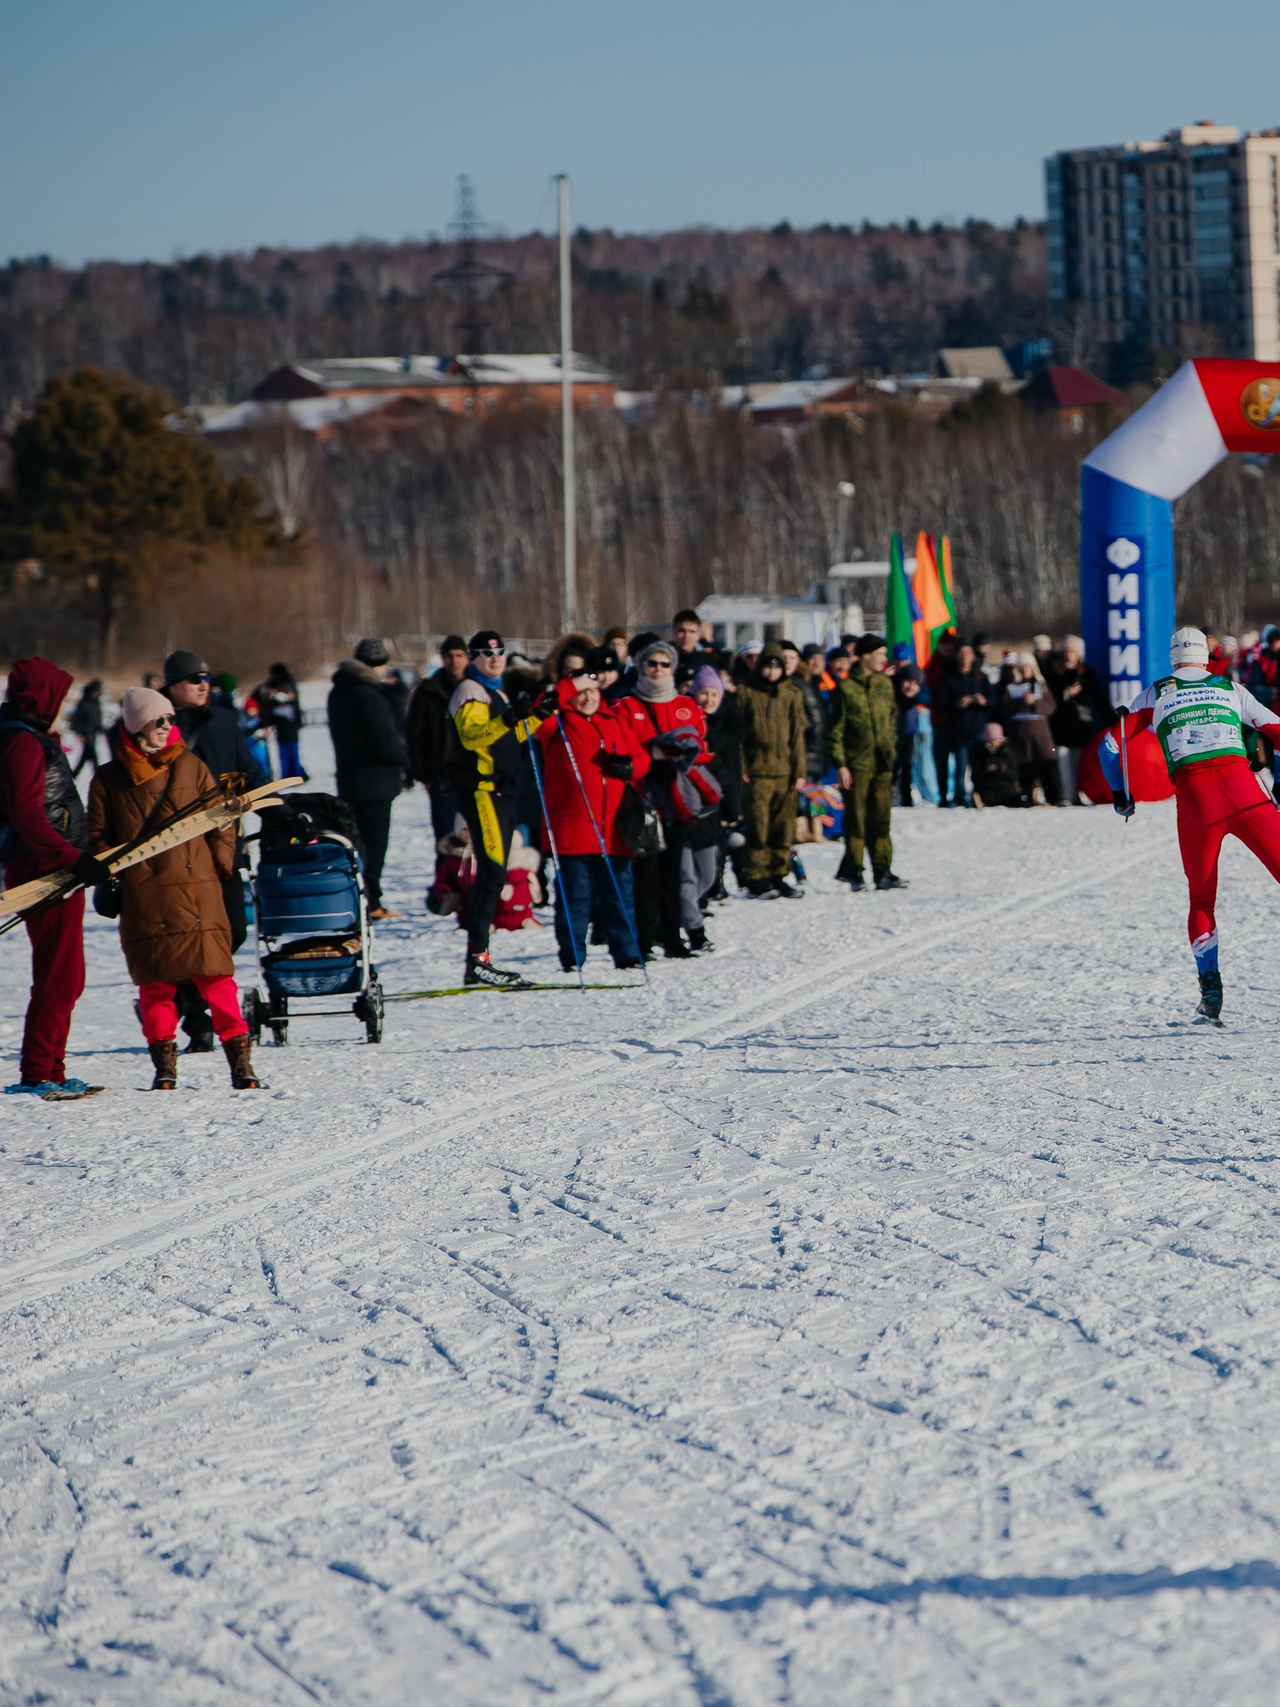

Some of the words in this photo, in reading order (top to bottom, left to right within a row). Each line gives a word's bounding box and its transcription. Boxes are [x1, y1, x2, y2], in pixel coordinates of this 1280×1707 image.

[1106, 537, 1142, 711] ФИНИШ
[1176, 689, 1216, 697] МАРАФОН
[1163, 698, 1193, 710] ЛЫЖНЯ
[1167, 708, 1207, 724] СЕЛЯНКИН
[1207, 708, 1232, 717] ДЕНИС
